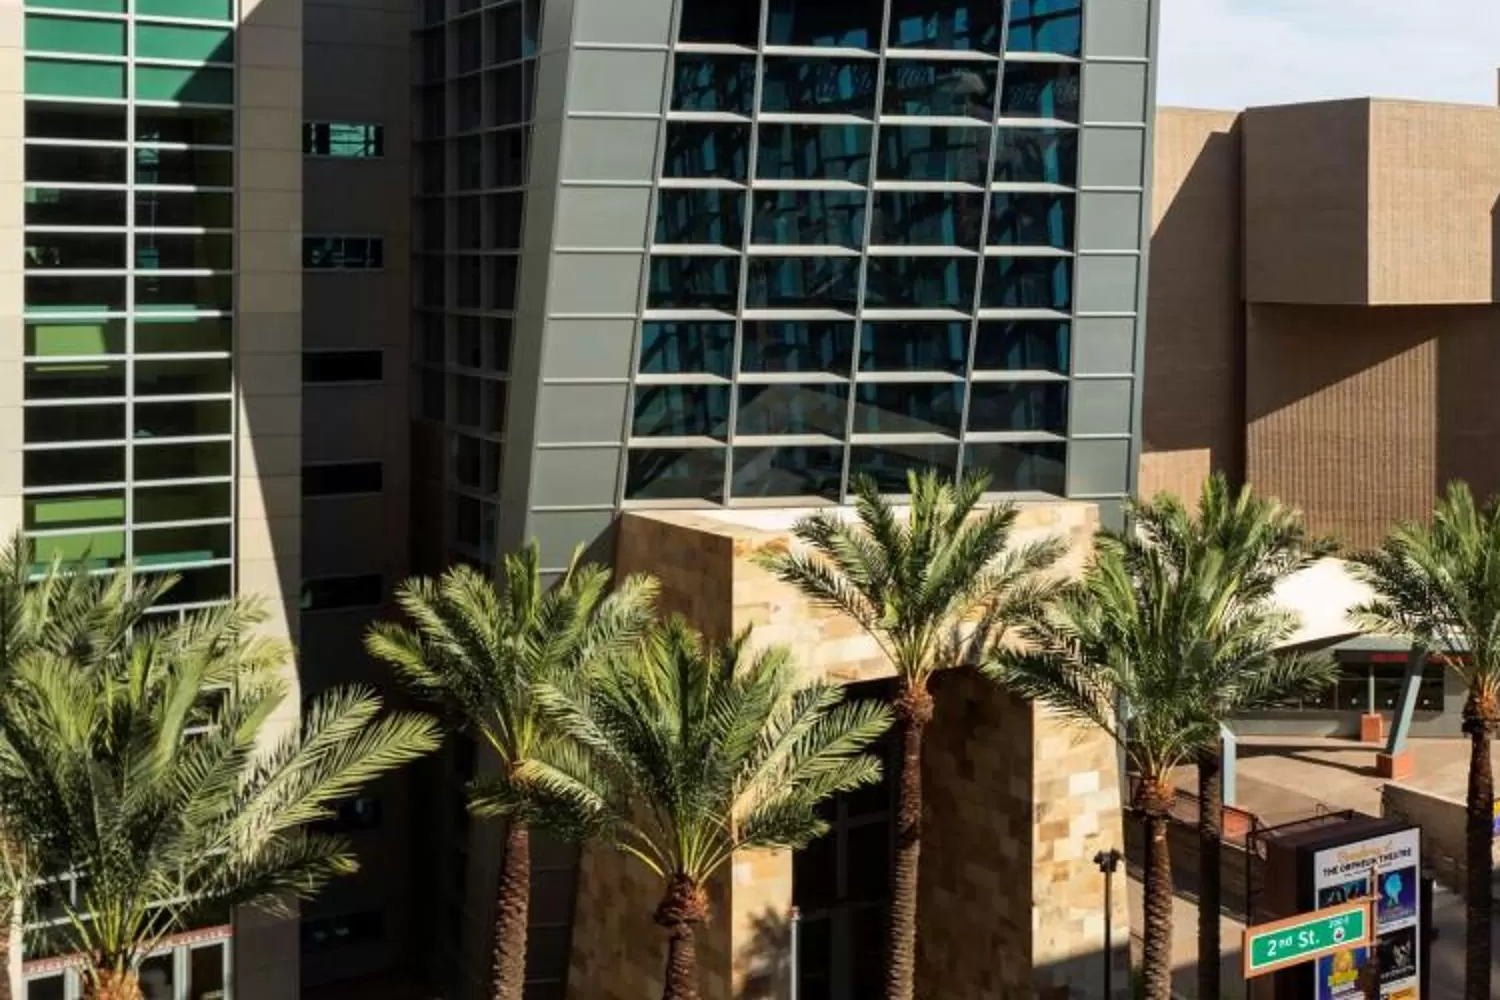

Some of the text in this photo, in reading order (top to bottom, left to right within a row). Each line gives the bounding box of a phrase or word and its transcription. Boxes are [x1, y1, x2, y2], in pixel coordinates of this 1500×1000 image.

[1323, 865, 1339, 877] THE
[1267, 929, 1320, 957] 2nd St.
